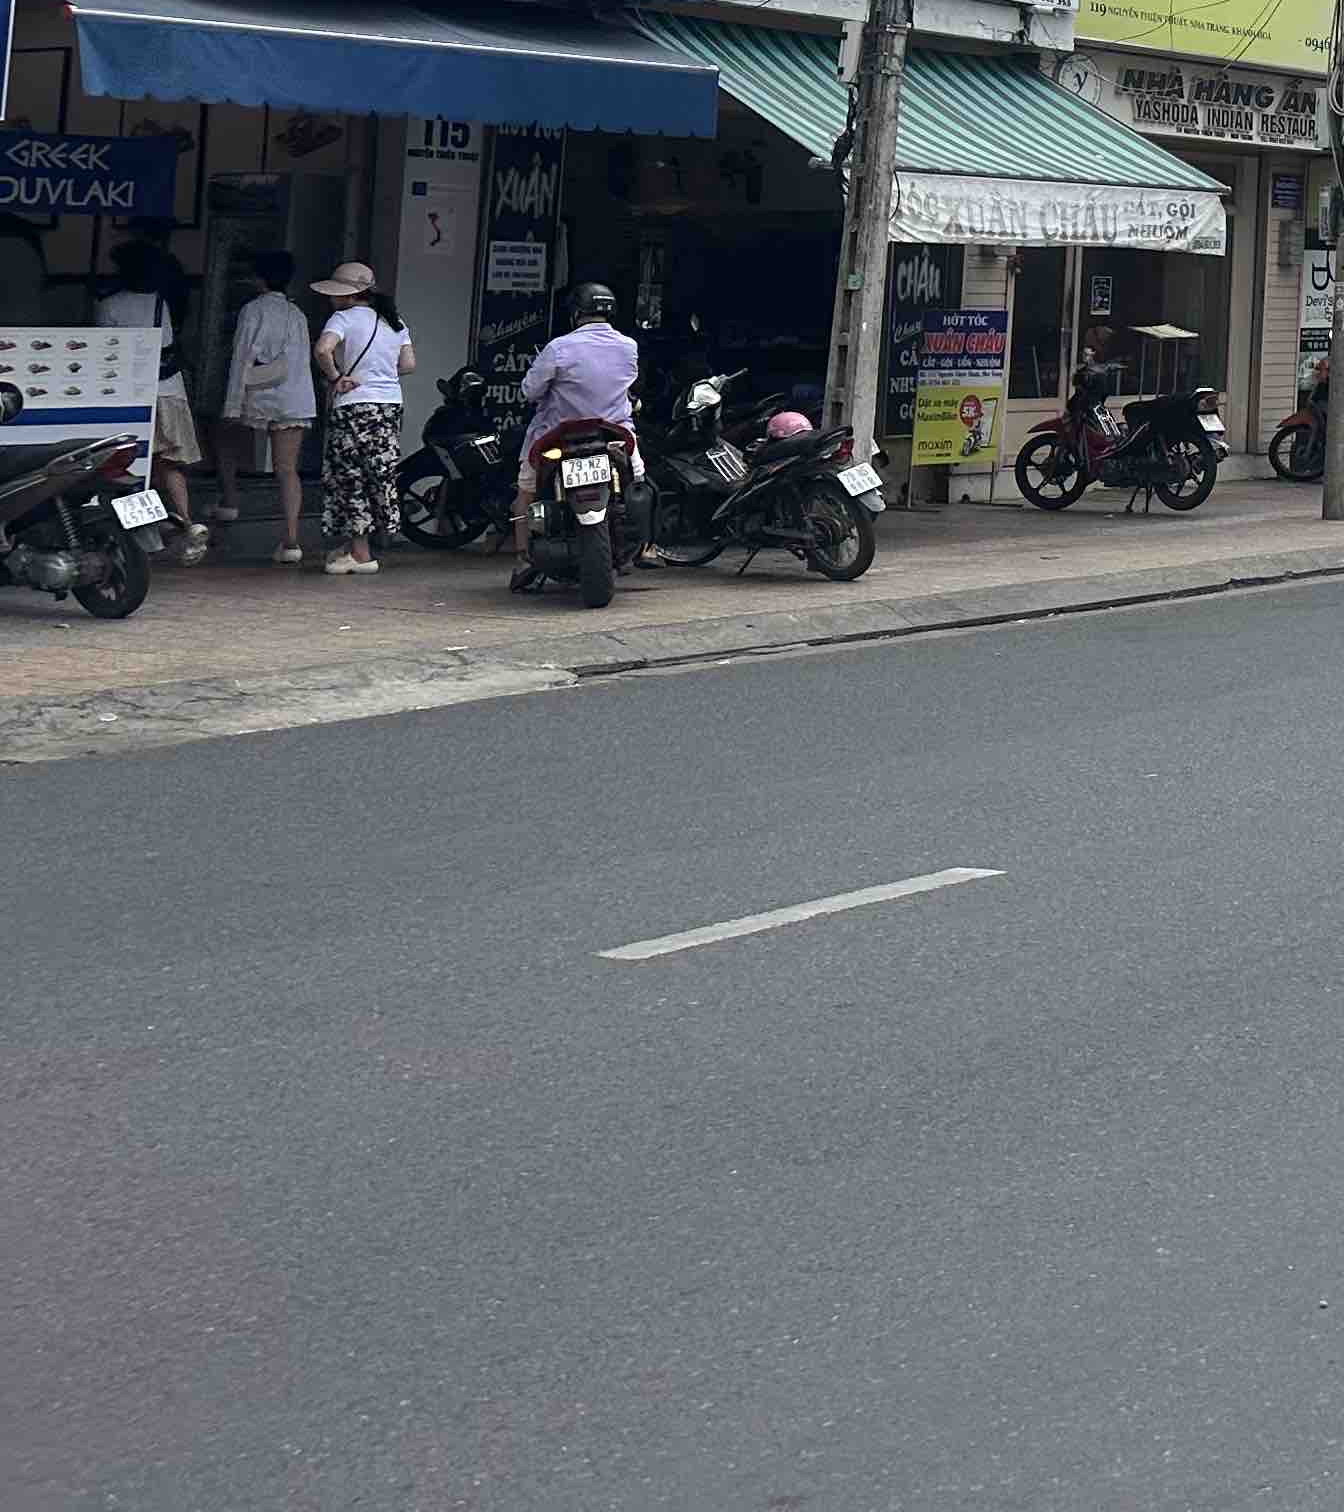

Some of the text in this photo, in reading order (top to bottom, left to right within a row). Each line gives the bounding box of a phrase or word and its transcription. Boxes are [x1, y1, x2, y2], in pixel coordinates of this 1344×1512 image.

[1089, 1, 1108, 17] 119
[1134, 97, 1199, 126] YASHODA
[1206, 107, 1254, 131] INDIAN
[5, 139, 112, 171] GREEK
[917, 438, 953, 451] maxim
